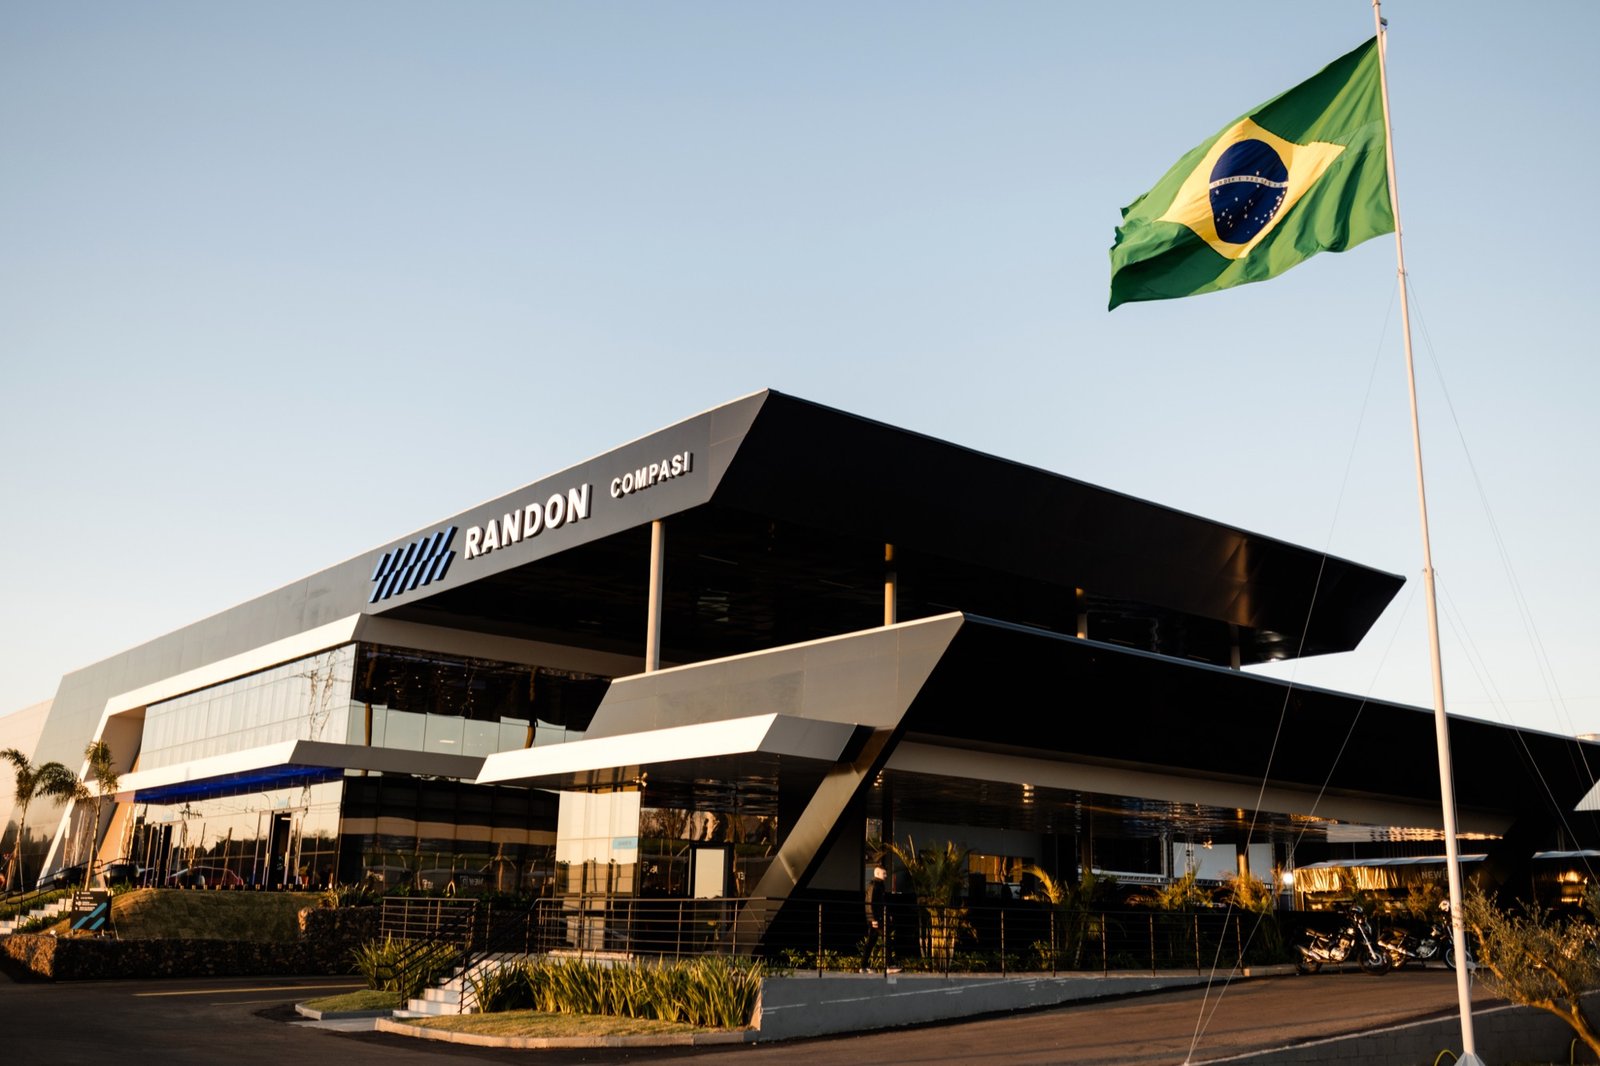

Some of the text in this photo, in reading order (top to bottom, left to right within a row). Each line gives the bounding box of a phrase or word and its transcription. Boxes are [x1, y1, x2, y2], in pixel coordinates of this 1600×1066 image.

[464, 451, 691, 560] RANDON COMPASI
[1421, 870, 1442, 880] NEW
